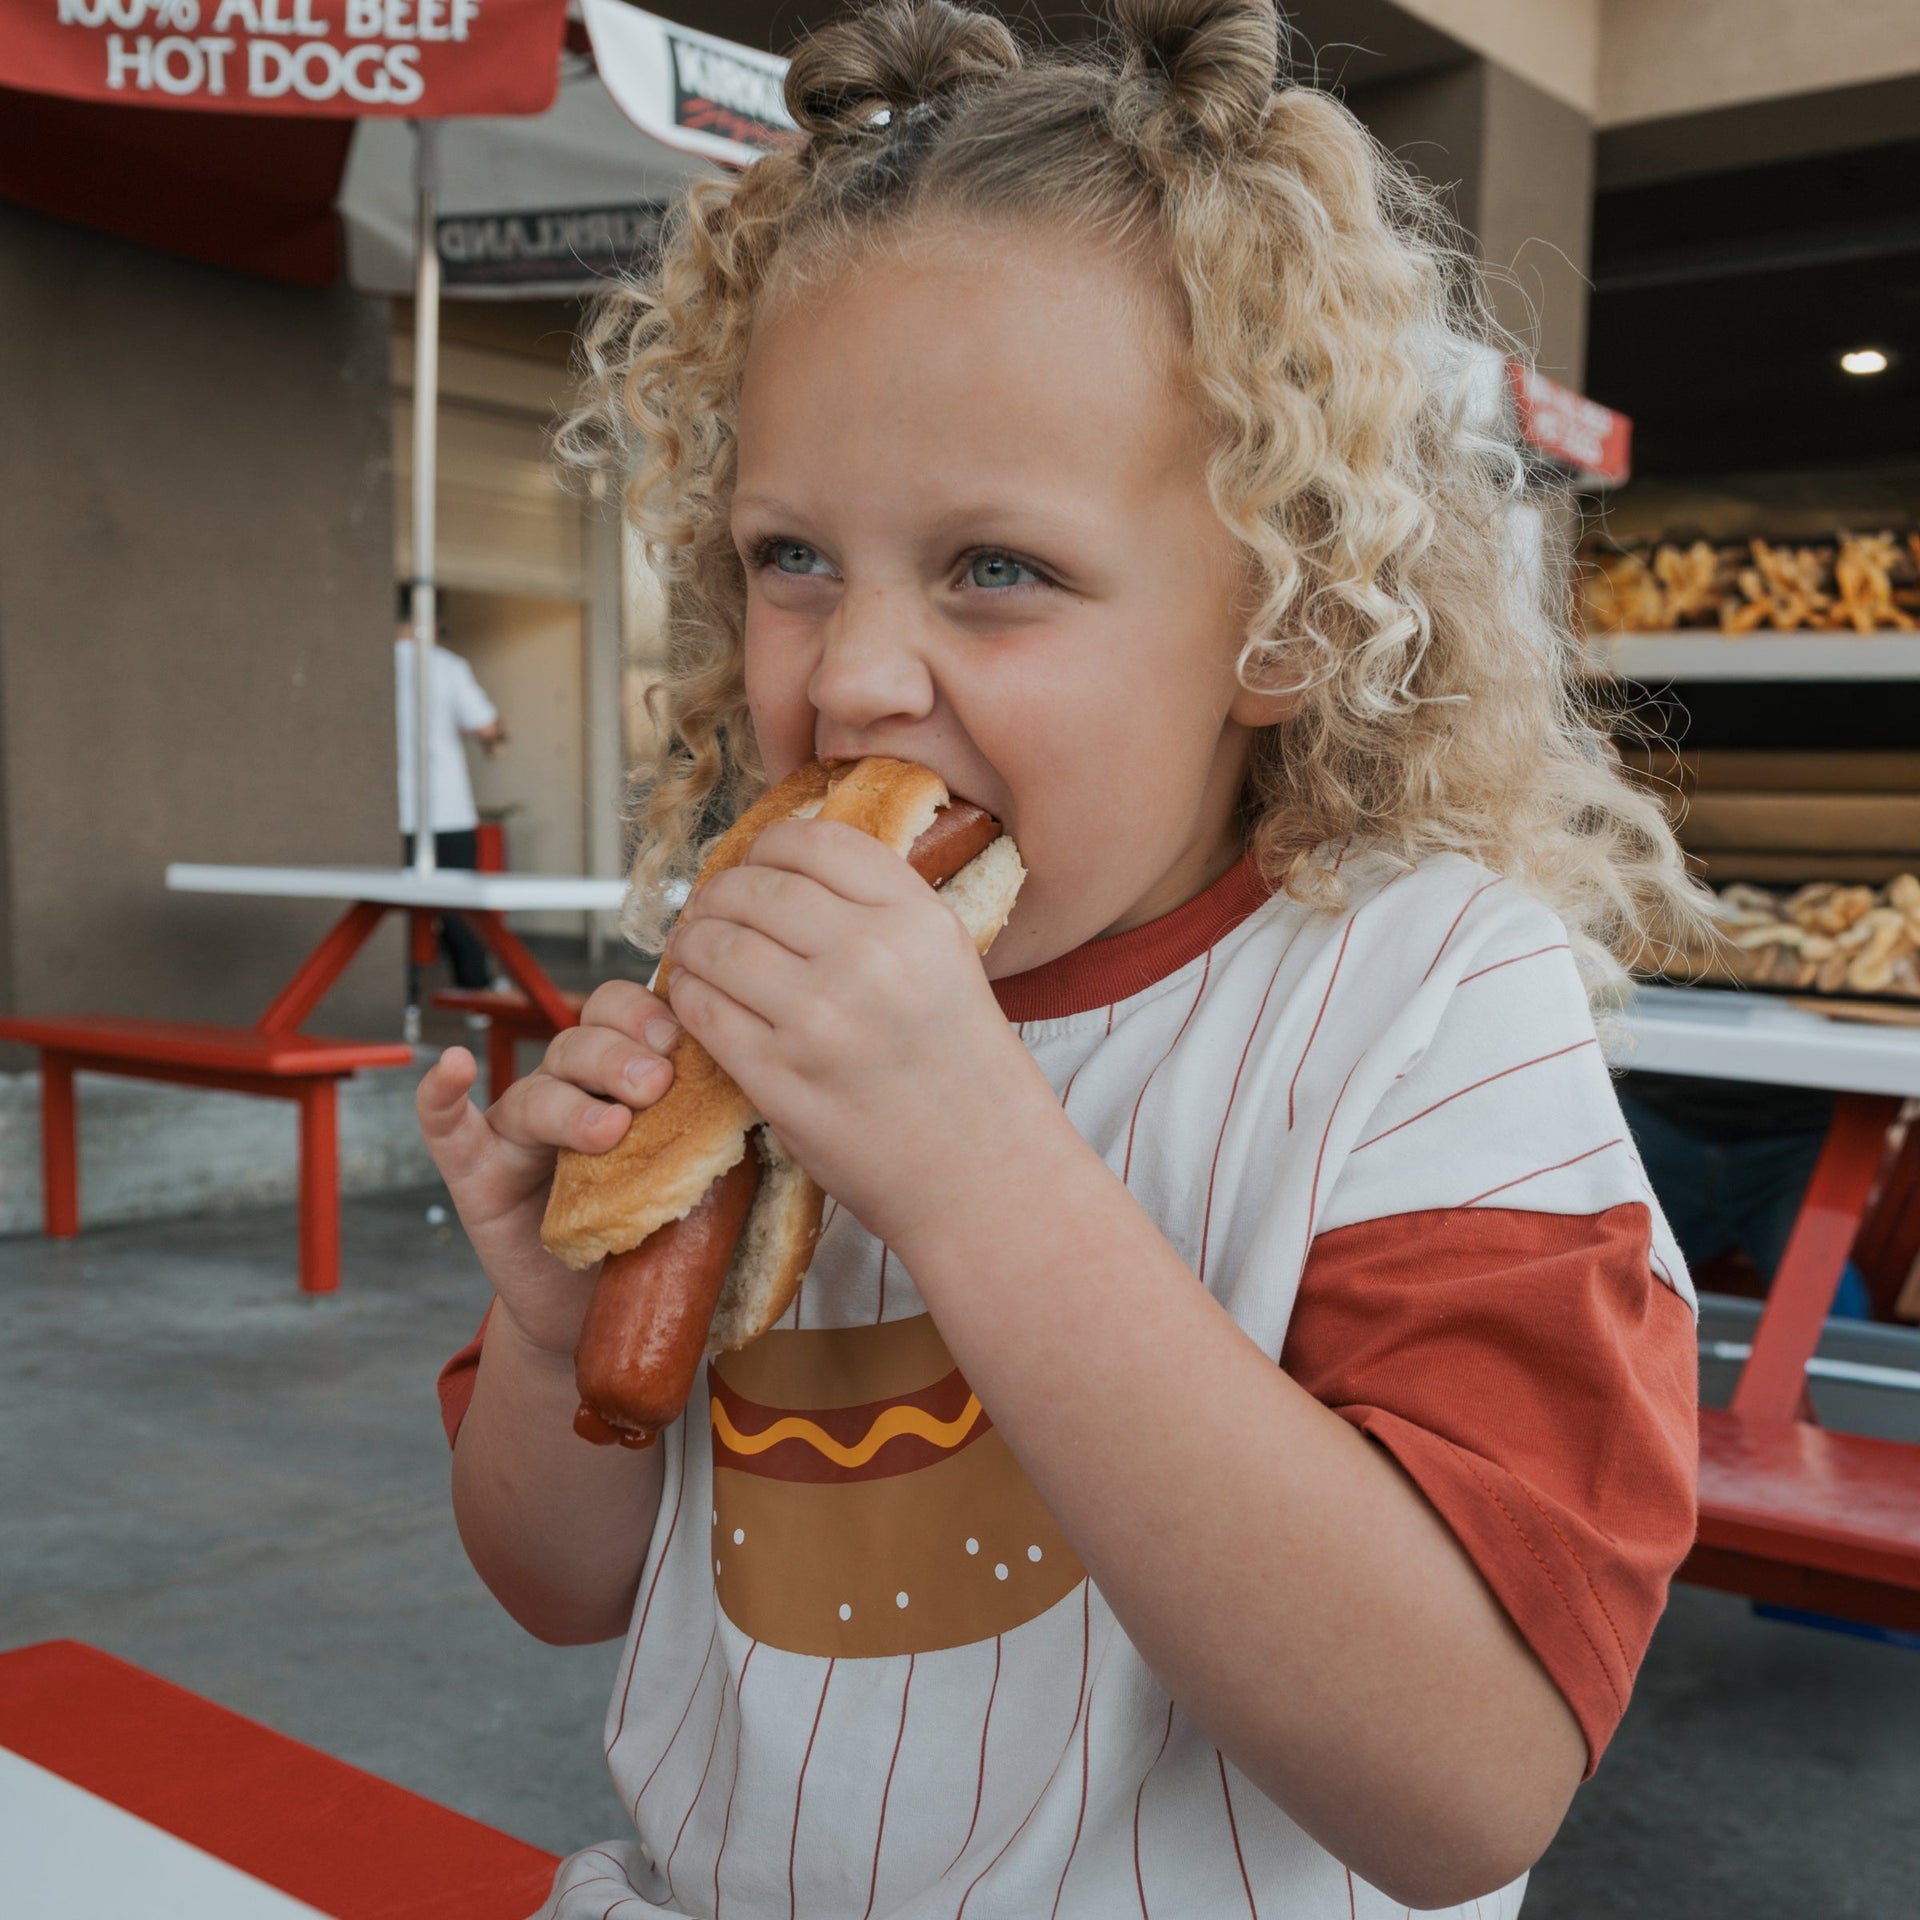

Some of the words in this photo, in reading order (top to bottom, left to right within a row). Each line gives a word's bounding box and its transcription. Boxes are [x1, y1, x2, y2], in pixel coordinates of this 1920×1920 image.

[212, 0, 329, 36] ALL
[345, 0, 481, 42] BEEF
[106, 33, 236, 95] HOT
[247, 39, 425, 104] DOGS
